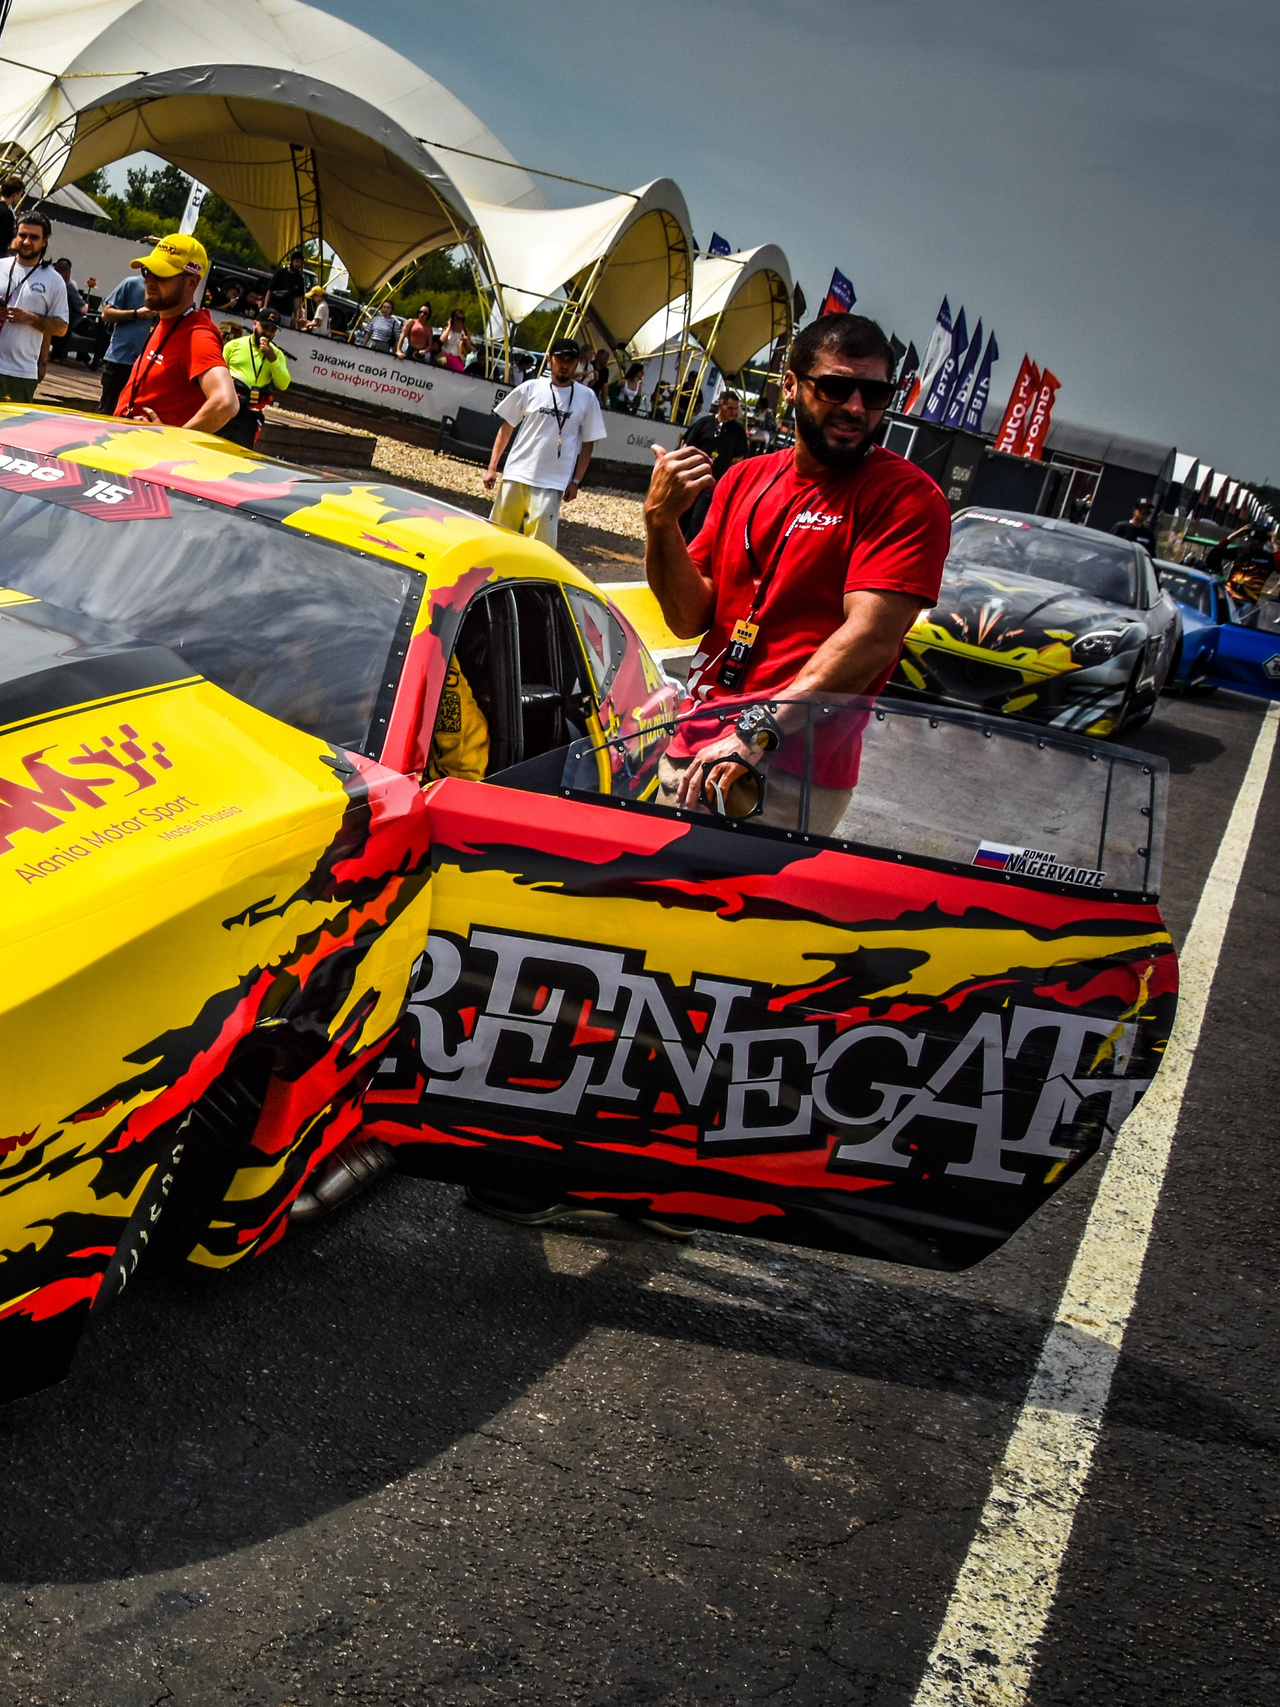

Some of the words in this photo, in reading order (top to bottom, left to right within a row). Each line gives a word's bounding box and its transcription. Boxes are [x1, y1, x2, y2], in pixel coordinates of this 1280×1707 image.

[310, 349, 355, 371] Закажи
[358, 362, 387, 379] свой
[389, 370, 434, 391] Порше
[312, 364, 328, 377] по
[330, 369, 425, 404] конфигуратору
[999, 373, 1032, 453] auto.ru
[81, 480, 134, 504] 15
[14, 845, 92, 885] Alania
[80, 816, 148, 849] Motor
[138, 794, 199, 822] Sport
[157, 820, 194, 842] Made
[191, 815, 207, 829] in
[202, 805, 243, 823] Russia
[1004, 853, 1106, 887] NAGERVADZE
[1022, 850, 1057, 863] ROMAN
